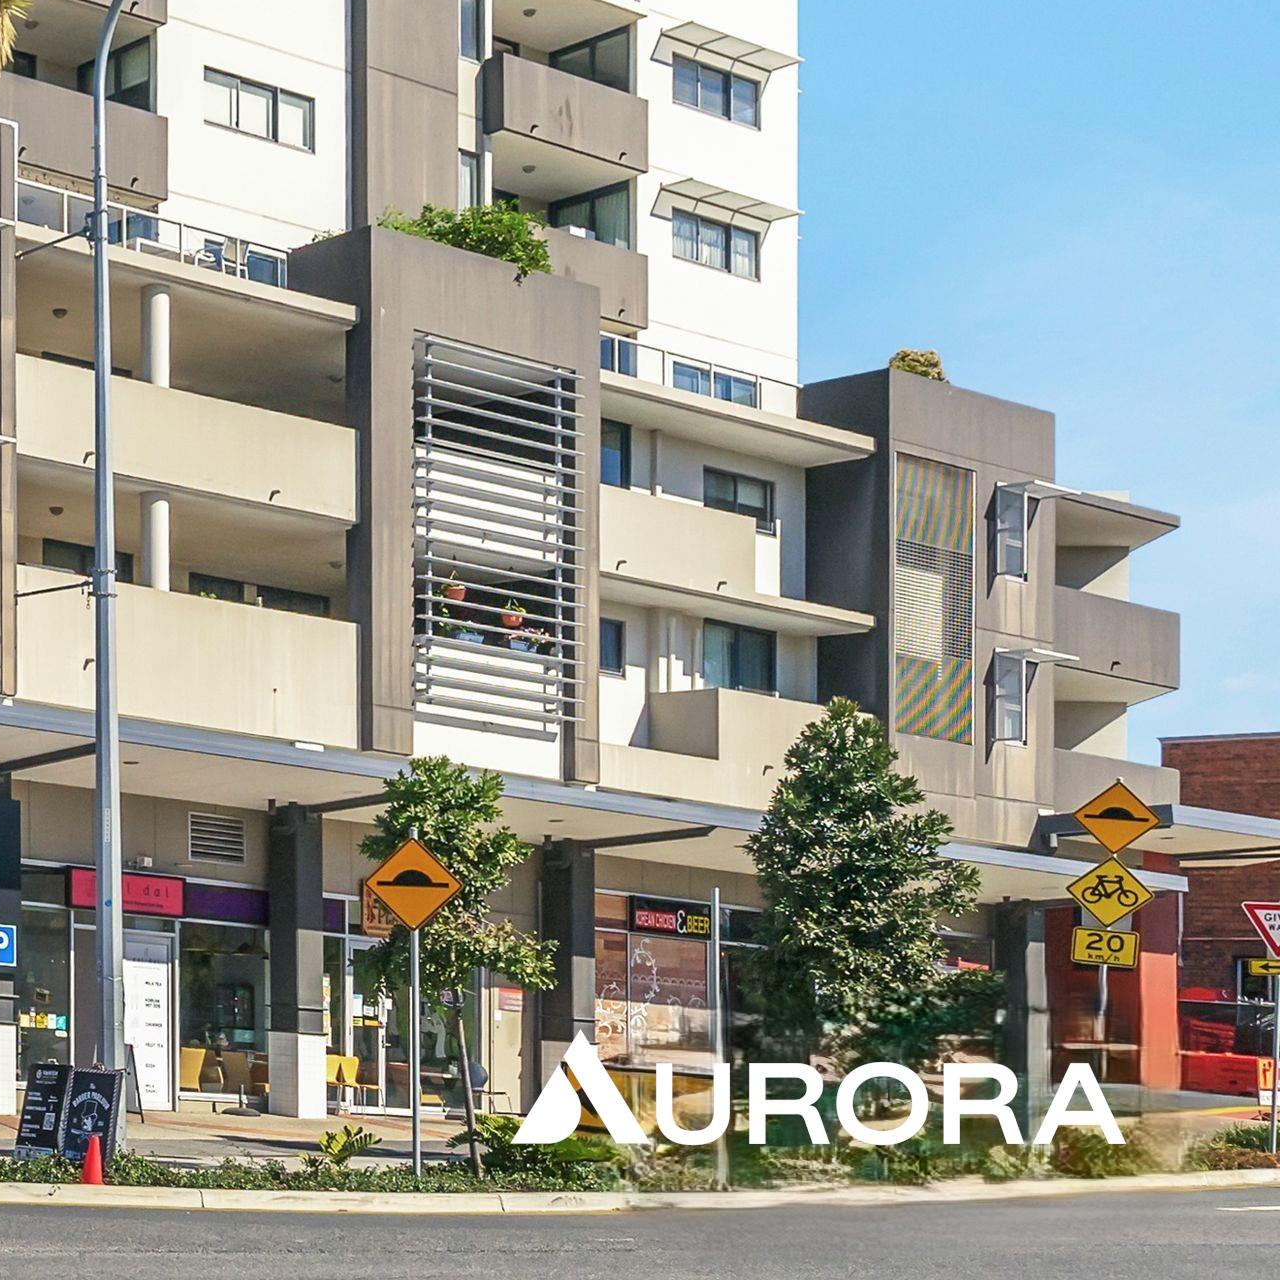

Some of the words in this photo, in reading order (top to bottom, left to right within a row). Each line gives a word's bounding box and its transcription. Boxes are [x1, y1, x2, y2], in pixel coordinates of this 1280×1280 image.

[687, 914, 710, 934] BEER
[1085, 932, 1125, 953] 20
[1087, 952, 1121, 962] km/h
